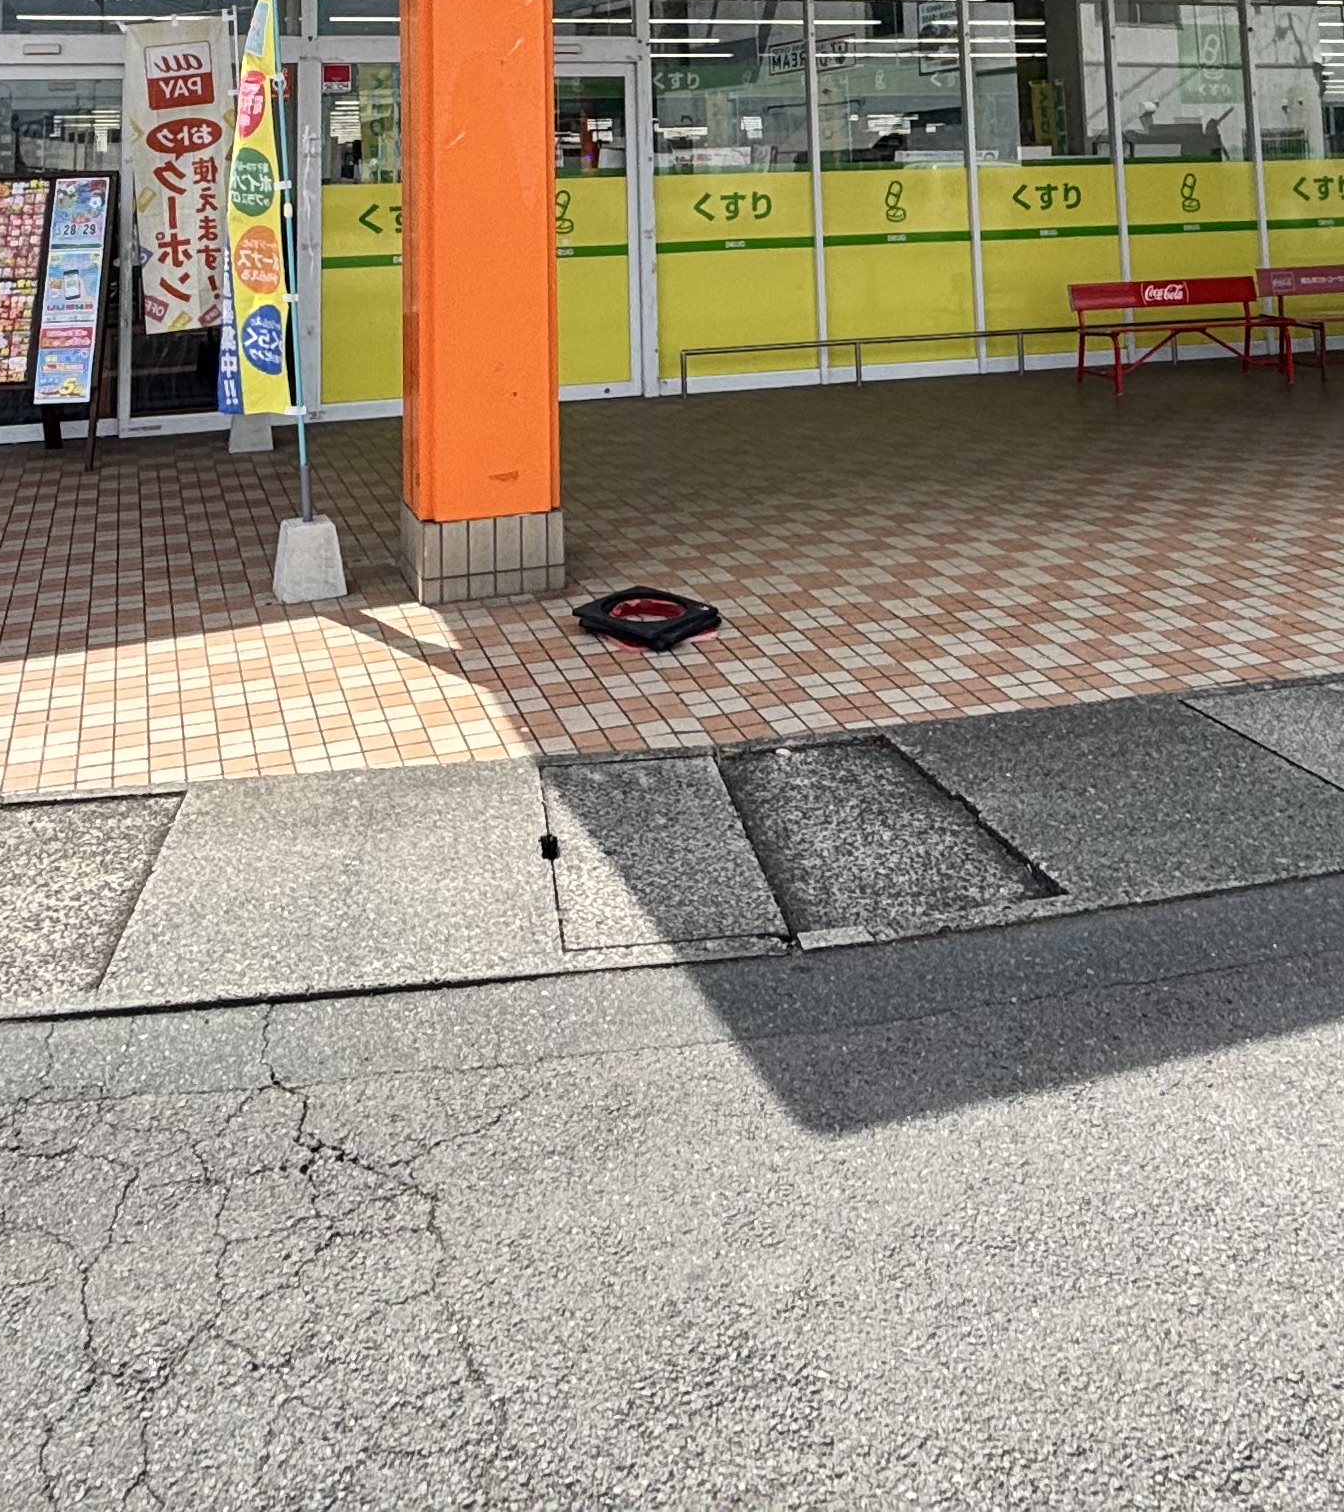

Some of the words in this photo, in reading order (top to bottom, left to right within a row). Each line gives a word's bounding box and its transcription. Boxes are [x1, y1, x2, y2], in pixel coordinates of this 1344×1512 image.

[693, 191, 773, 221] くすり
[1012, 183, 1082, 210] くすり
